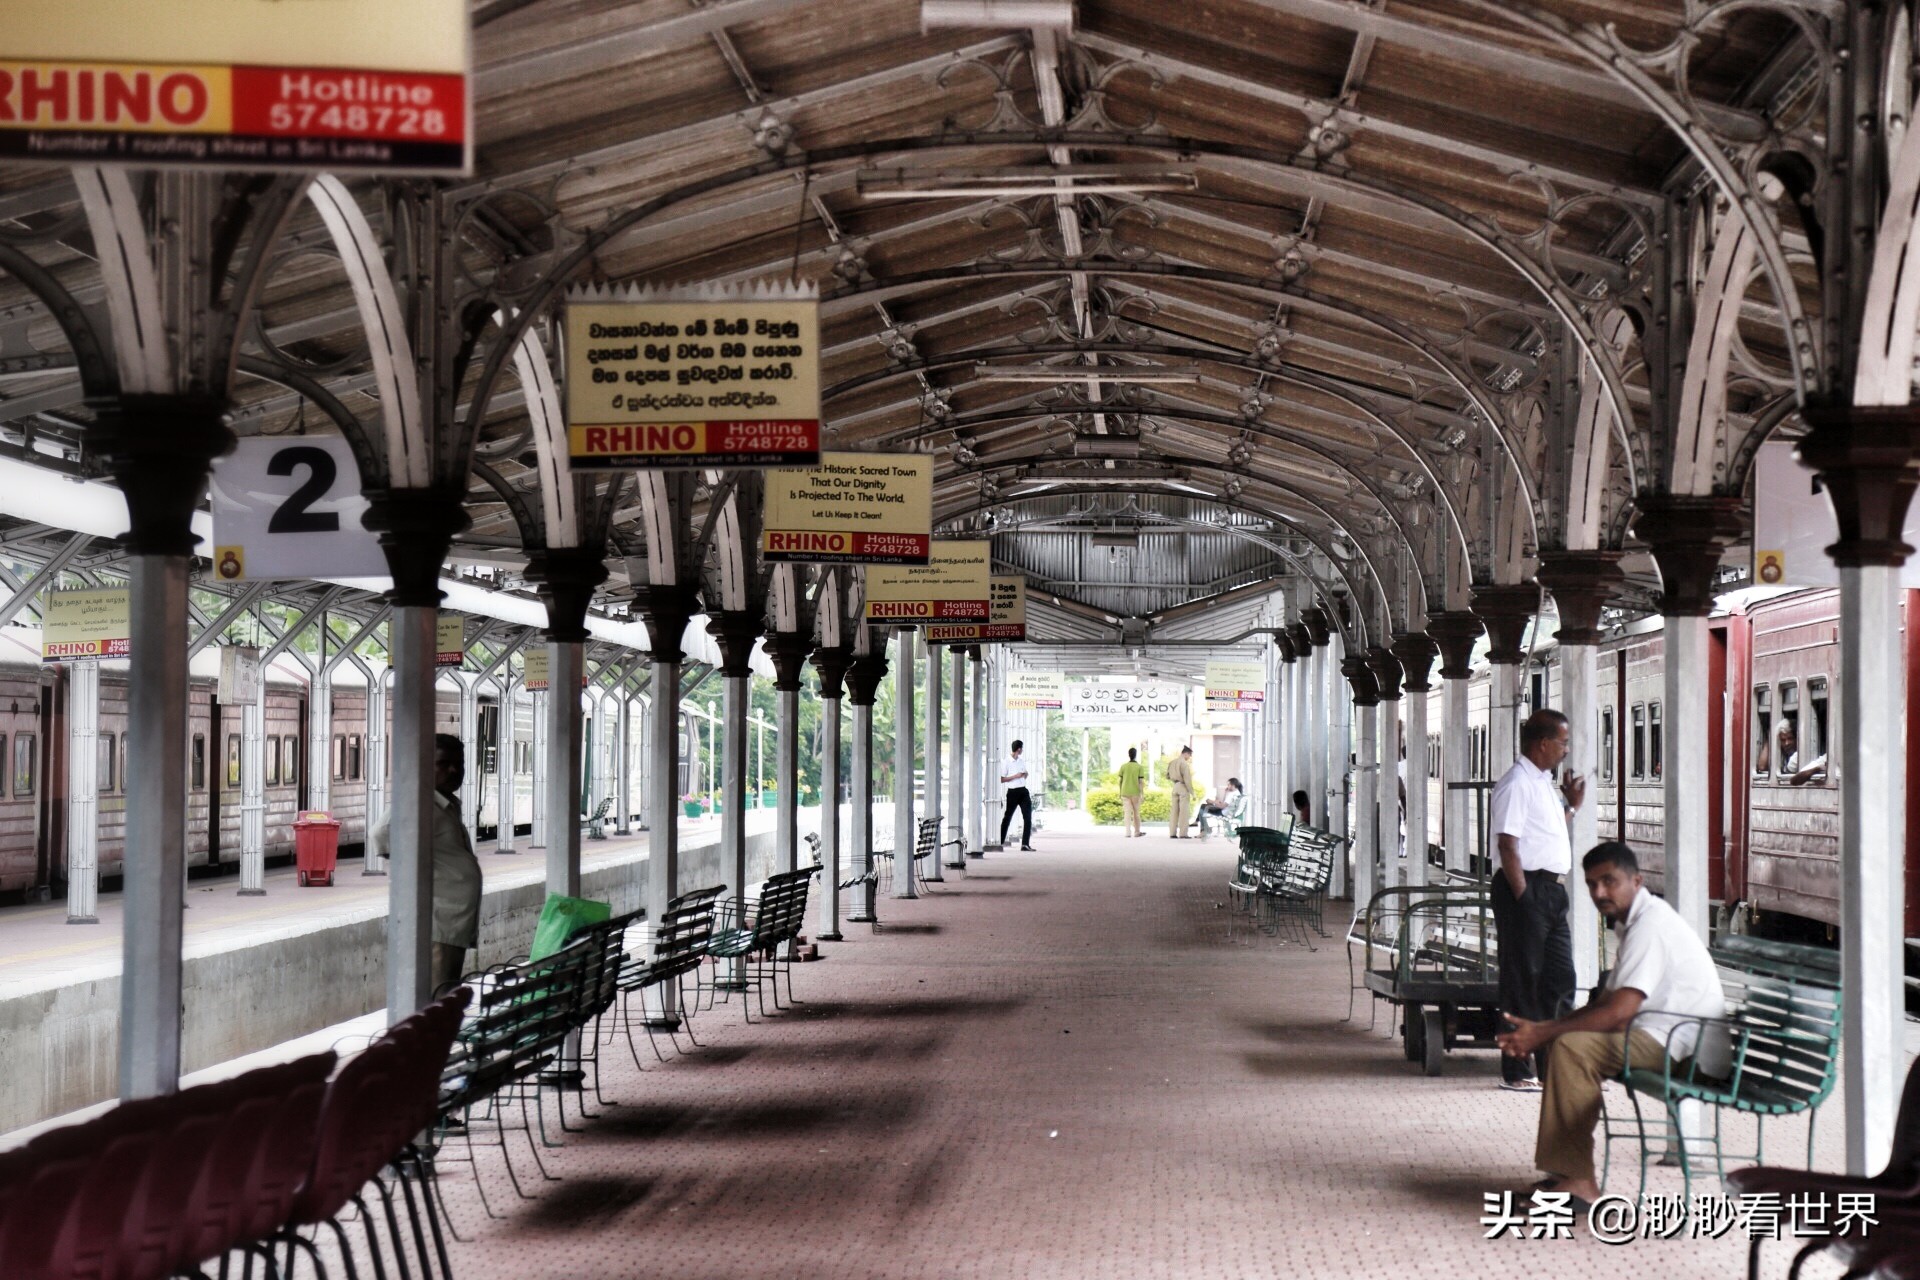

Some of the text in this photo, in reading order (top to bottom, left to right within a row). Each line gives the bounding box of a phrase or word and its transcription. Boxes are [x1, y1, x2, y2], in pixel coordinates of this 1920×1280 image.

[281, 74, 433, 104] Hotline
[270, 103, 446, 136] 5748728
[28, 134, 391, 161] Number 1 roofing sheet in Sri Lanka
[729, 422, 802, 435] Hotline
[585, 424, 696, 452] RHINO
[724, 436, 809, 450] 5748728
[610, 457, 648, 466] Number
[659, 456, 694, 467] roofing
[696, 455, 724, 464] sheet
[725, 455, 735, 464] in
[737, 454, 751, 463] Sri
[753, 454, 783, 463] Lanka
[824, 465, 857, 474] Historic
[860, 466, 890, 476] Sacred
[892, 467, 917, 477] Town
[266, 446, 340, 533] 2
[810, 477, 886, 490] That Our Dignity
[790, 490, 796, 500] Is
[798, 490, 841, 502] Projected
[844, 492, 854, 502] To
[857, 492, 874, 502] The
[812, 510, 824, 518] Let
[825, 510, 834, 518] Us
[834, 511, 851, 520] Keep
[769, 532, 845, 552] RHINO
[867, 534, 917, 545] Hotline
[863, 544, 921, 554] 5748728
[820, 554, 844, 562] roofing
[872, 602, 928, 616] RHINO
[932, 626, 976, 638] RHINO
[48, 642, 96, 655] RHINO
[1081, 688, 1158, 702] මහනුවර
[1126, 704, 1178, 712] KANDY
